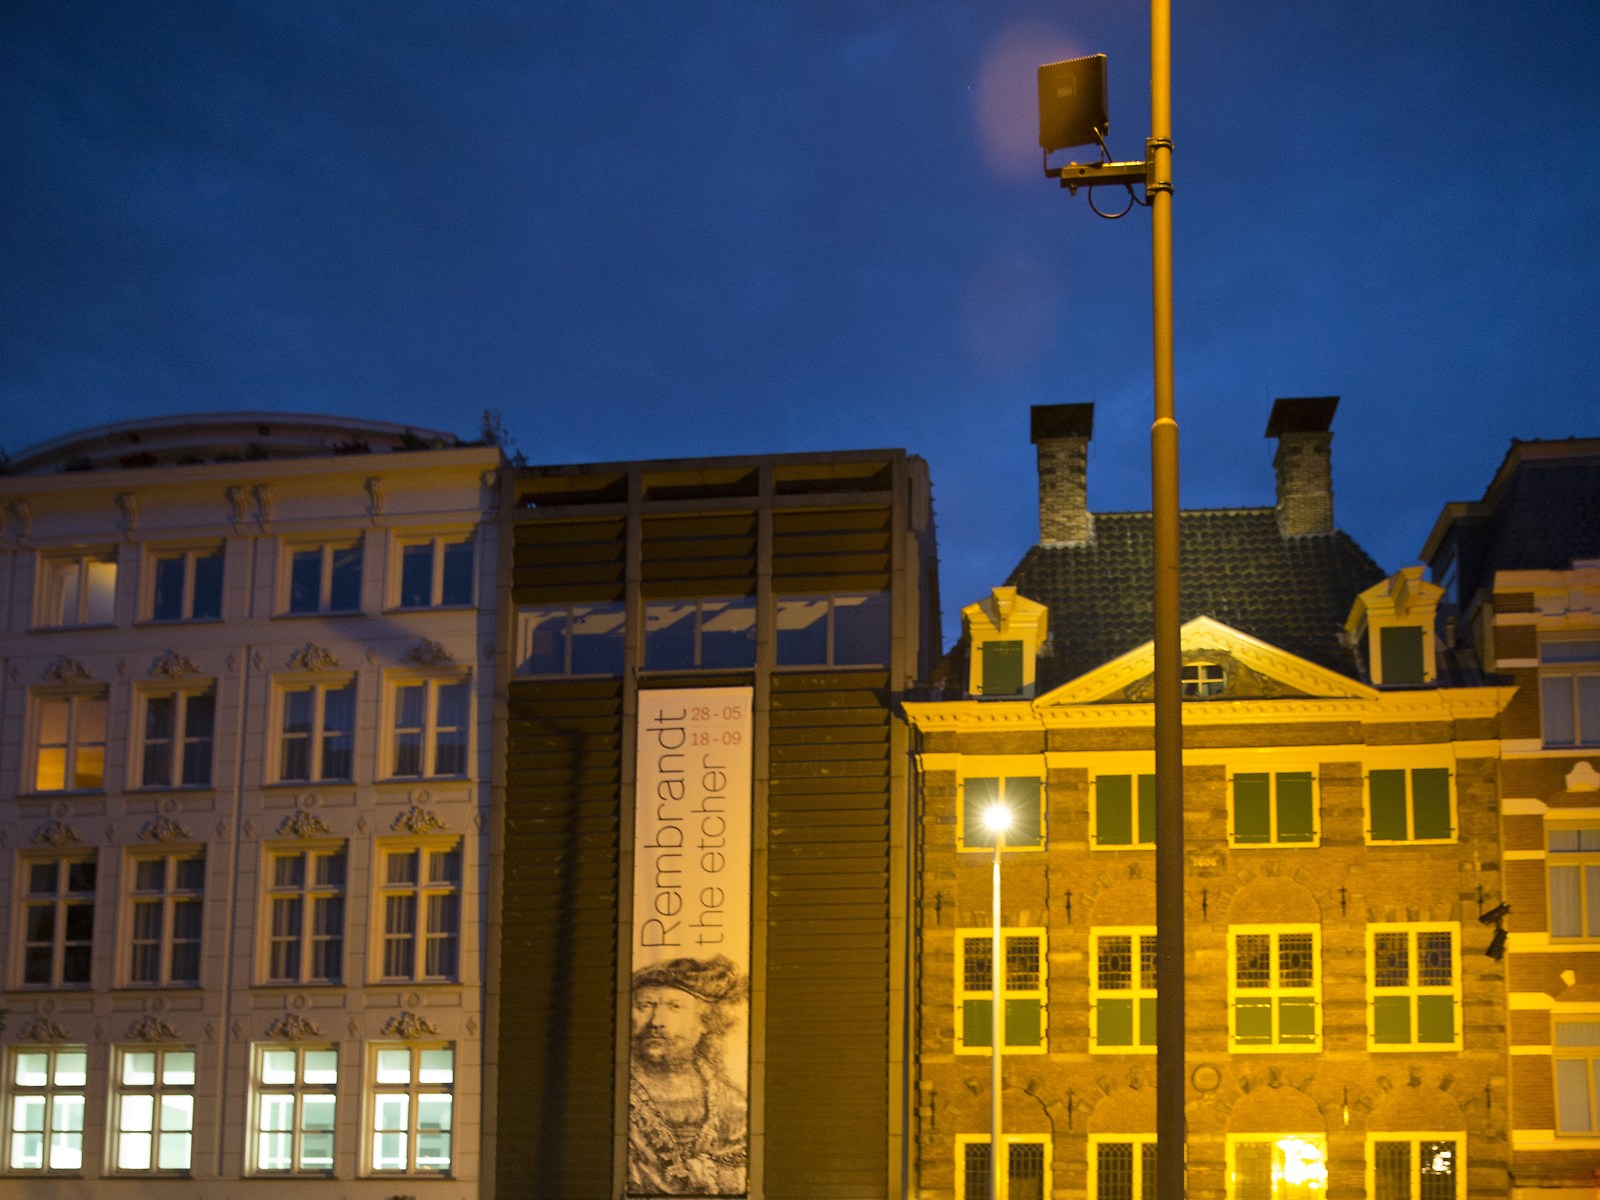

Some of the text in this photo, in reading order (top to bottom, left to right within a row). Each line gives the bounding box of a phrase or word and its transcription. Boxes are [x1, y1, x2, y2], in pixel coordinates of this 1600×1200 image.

[691, 706, 710, 721] 28
[722, 706, 741, 721] 05
[691, 732, 710, 746] 18
[722, 731, 741, 746] 09
[641, 708, 687, 947] Rembrandt
[689, 753, 727, 945] the etcher
